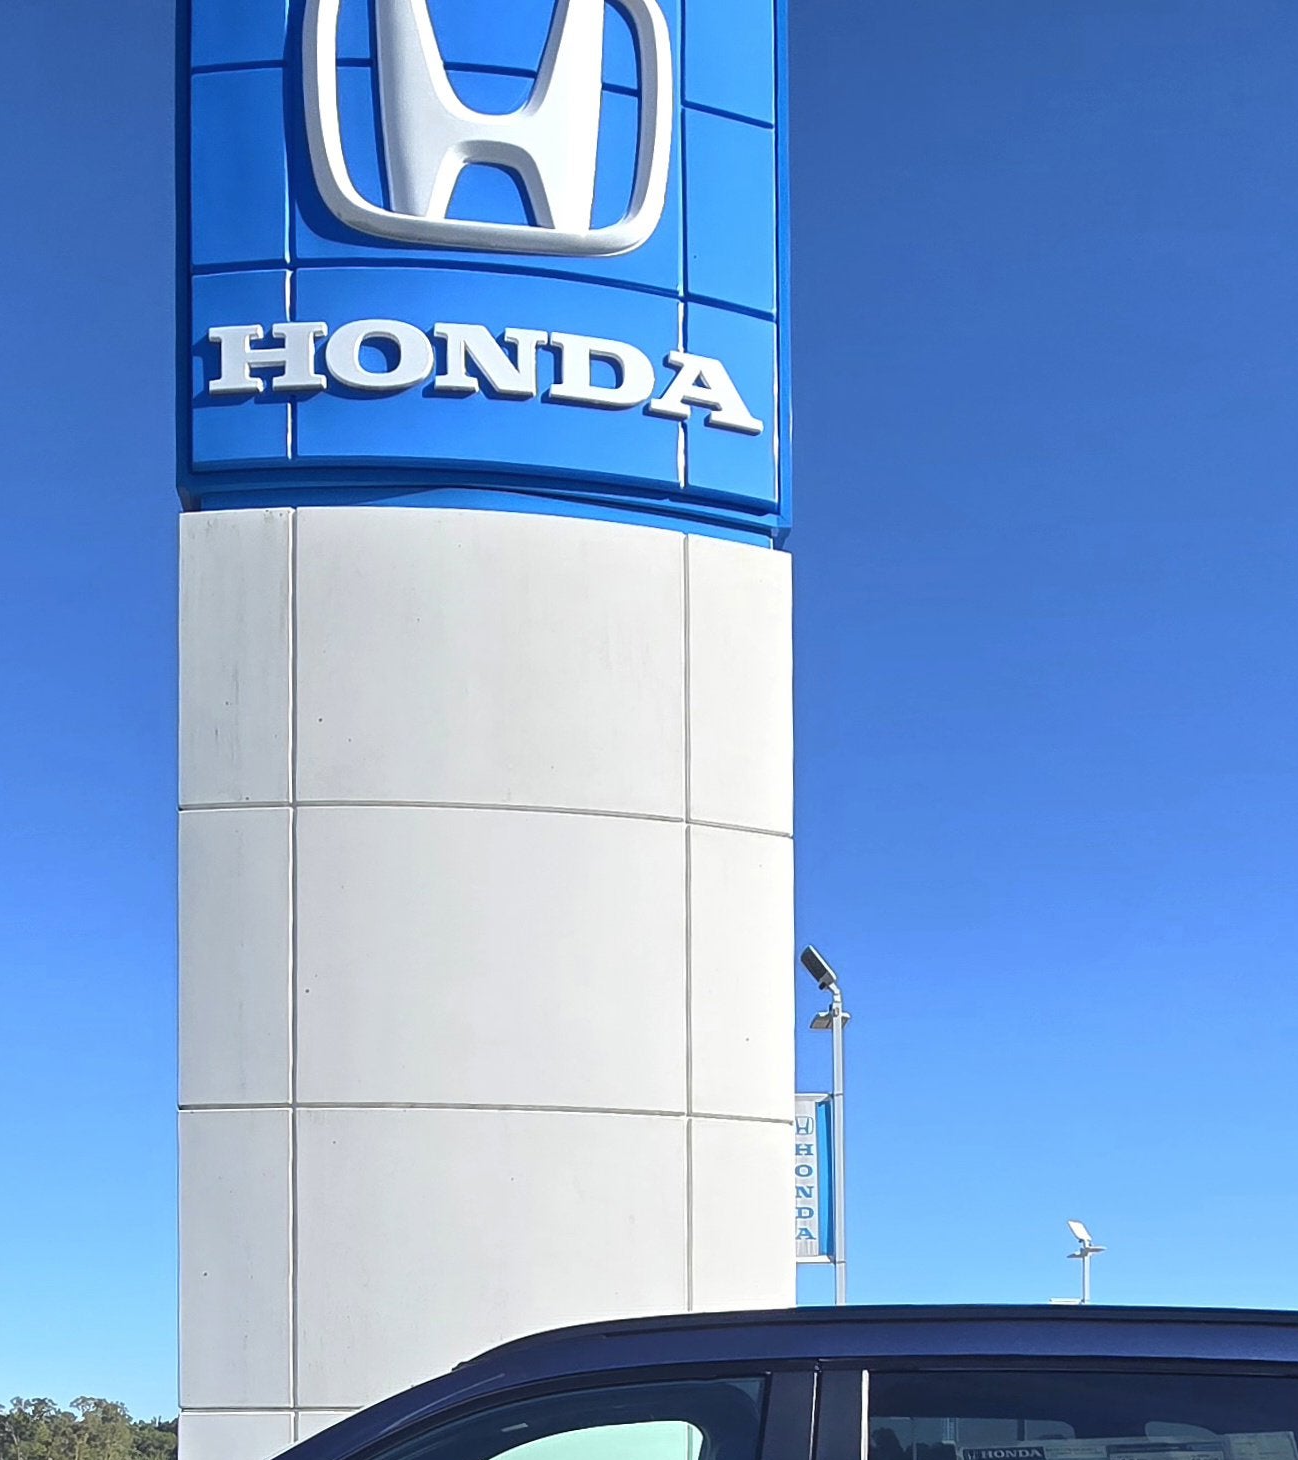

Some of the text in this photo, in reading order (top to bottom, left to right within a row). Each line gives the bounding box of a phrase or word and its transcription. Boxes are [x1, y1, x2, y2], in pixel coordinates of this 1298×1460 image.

[208, 318, 764, 436] HONDA
[795, 1143, 816, 1240] HONDA
[981, 1448, 1042, 1460] HONDA
